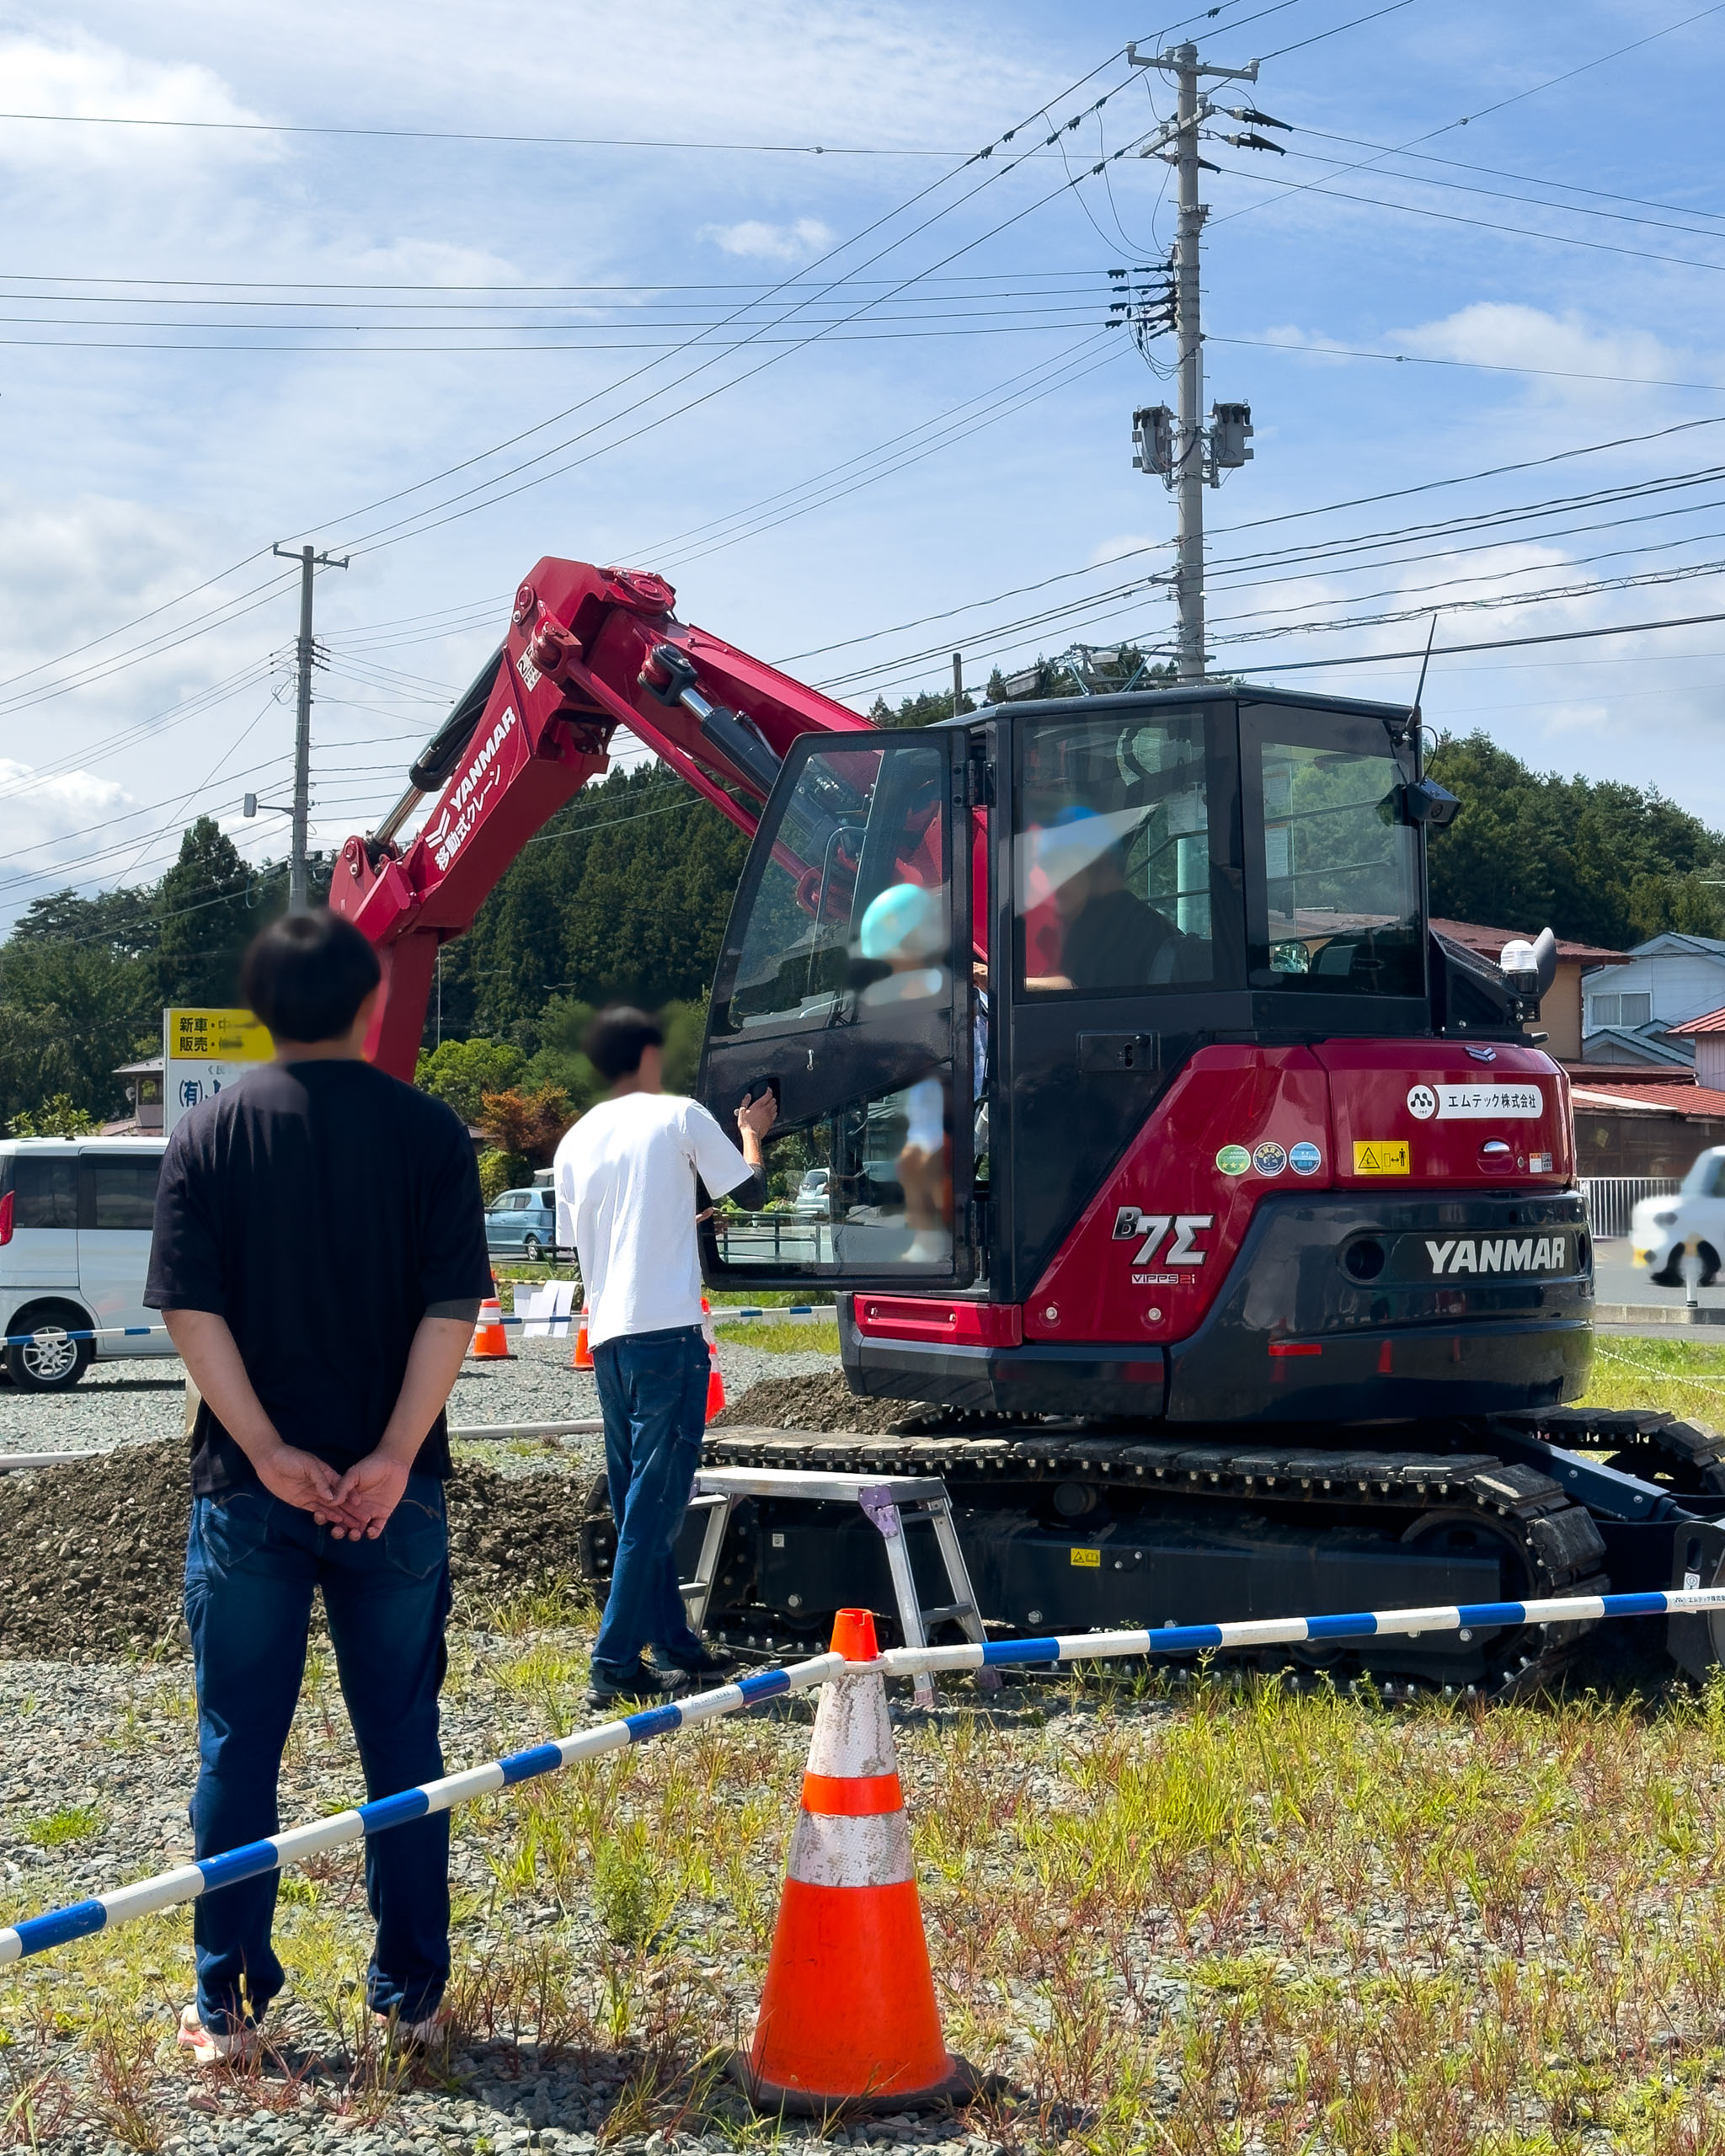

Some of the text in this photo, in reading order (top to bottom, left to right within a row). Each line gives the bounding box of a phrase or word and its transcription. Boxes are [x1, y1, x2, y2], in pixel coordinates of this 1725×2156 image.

[449, 706, 516, 813] YANMAR
[434, 764, 501, 873] 移動式クレーン
[1448, 1093, 1537, 1109] エムテック株式会社
[1425, 1237, 1566, 1274] YANMAR
